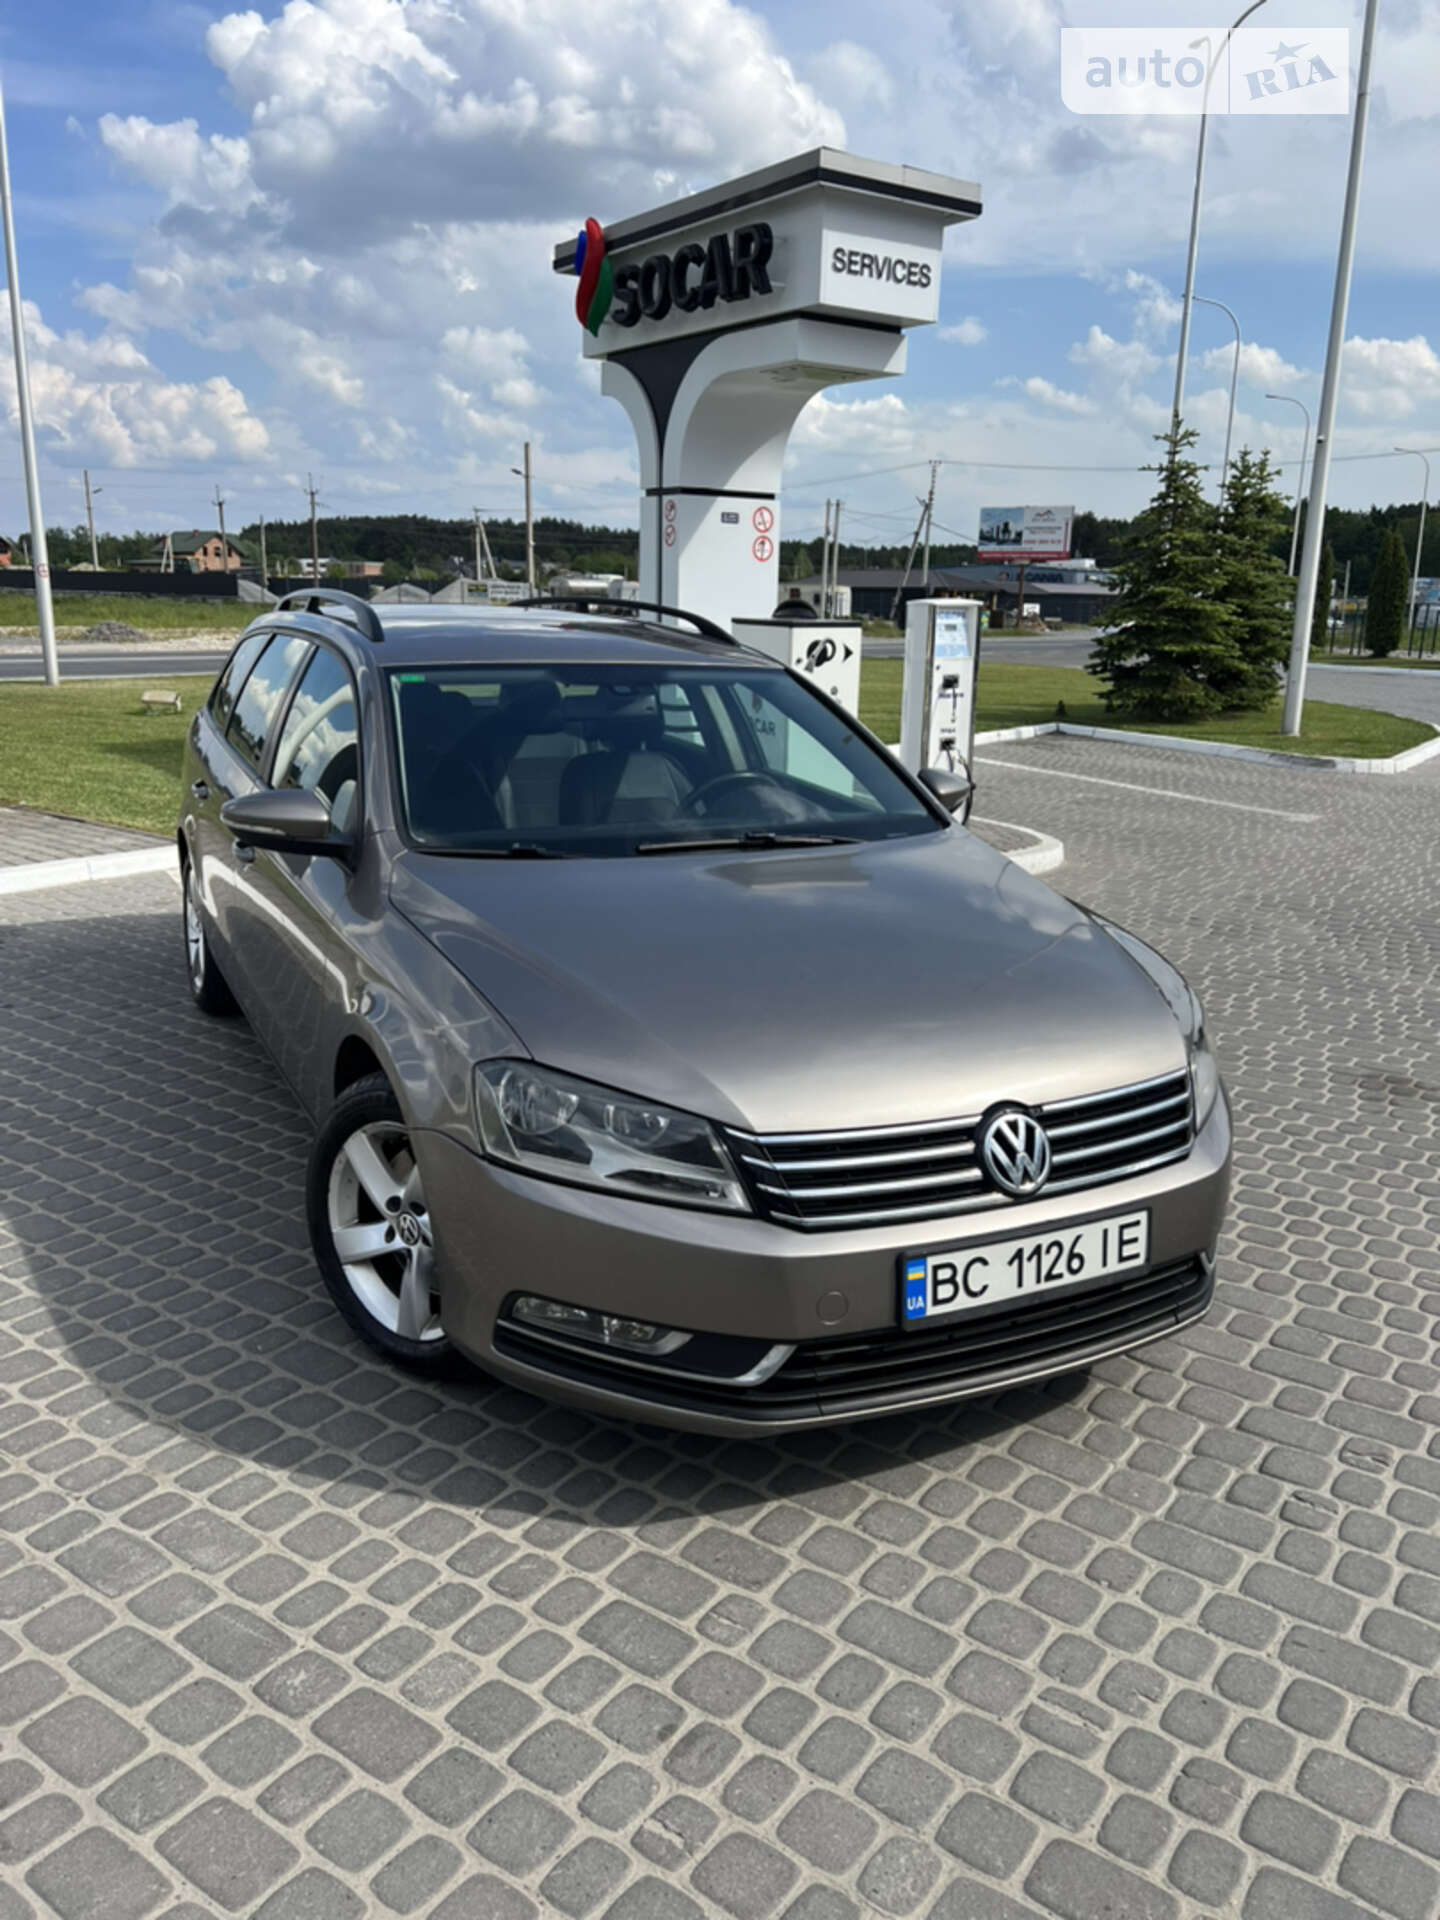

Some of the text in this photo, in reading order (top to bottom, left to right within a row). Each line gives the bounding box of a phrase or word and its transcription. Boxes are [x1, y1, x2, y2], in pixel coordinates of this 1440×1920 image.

[611, 221, 774, 328] SOCAR
[832, 247, 932, 288] SERVICES
[931, 1219, 1141, 1306] BC 1126 IE
[906, 1295, 925, 1311] UA
